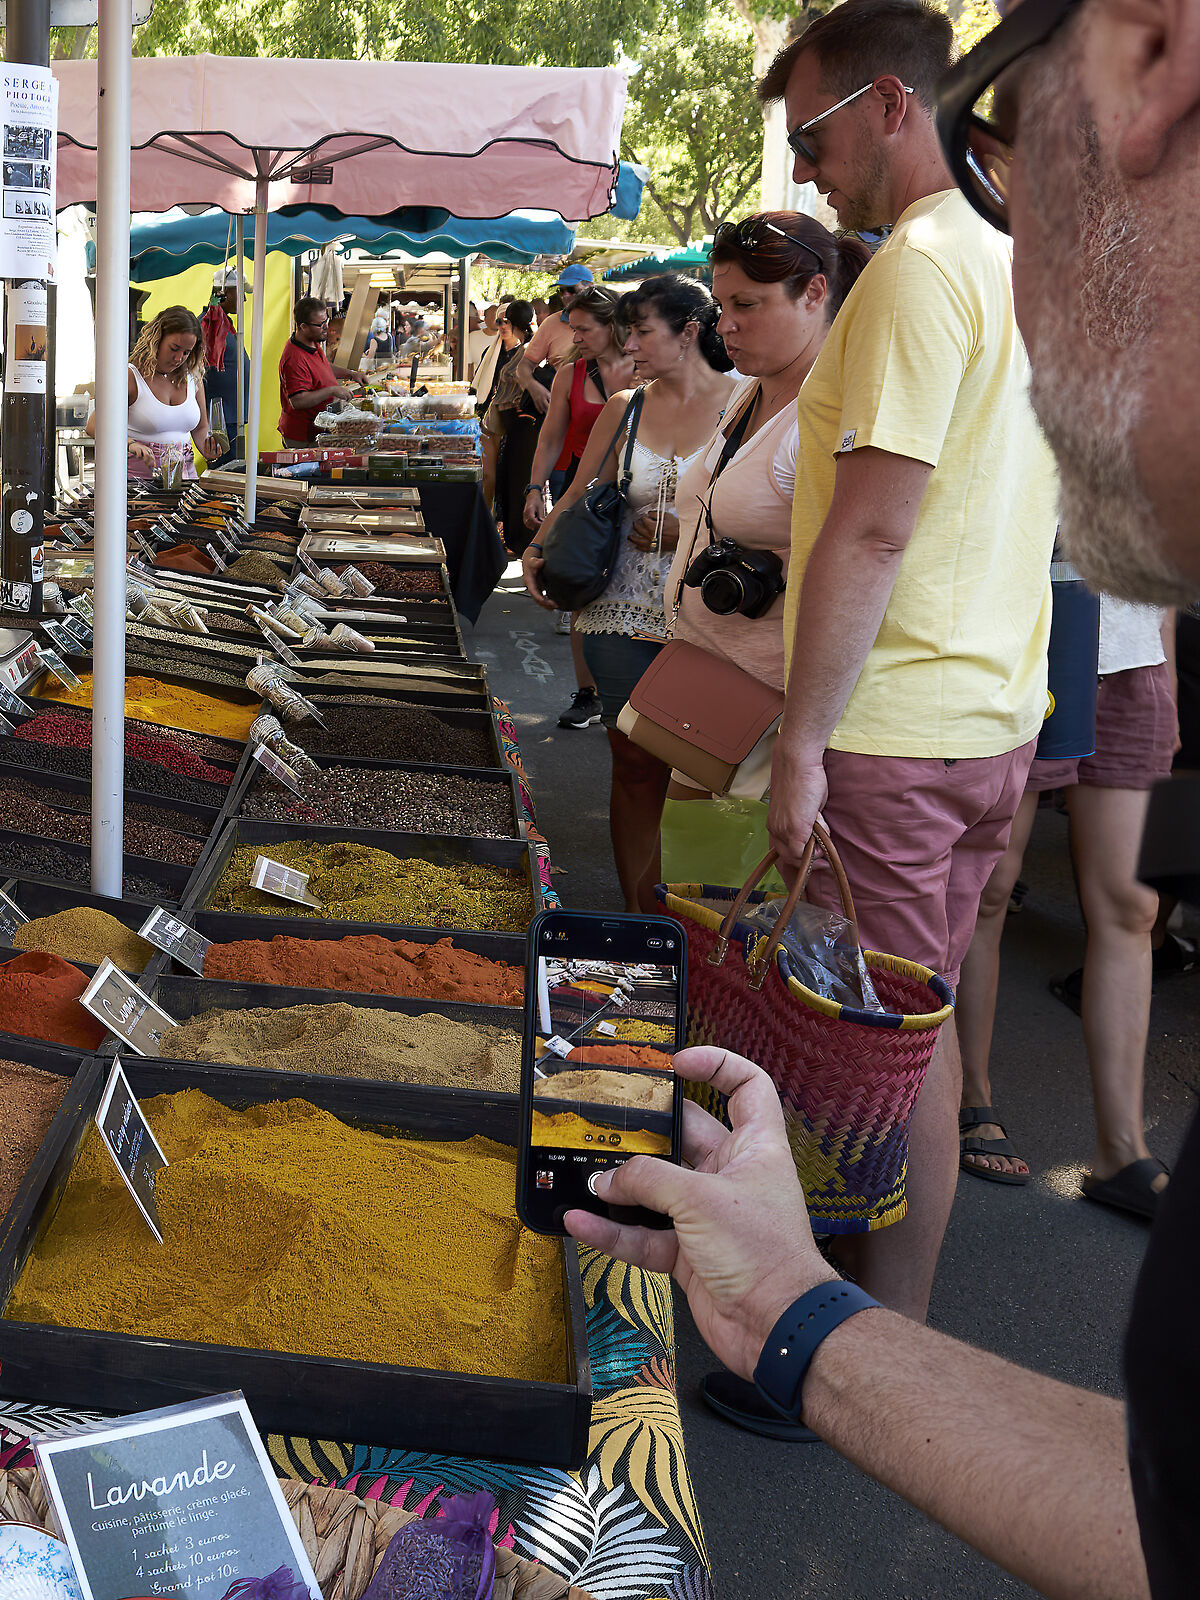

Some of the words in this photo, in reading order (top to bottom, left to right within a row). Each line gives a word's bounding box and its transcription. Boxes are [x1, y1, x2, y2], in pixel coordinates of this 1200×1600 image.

[4, 77, 45, 91] SERGE
[102, 996, 137, 1024] Cumin
[87, 1449, 236, 1510] Lavande
[91, 1514, 132, 1532] Cuisine,
[133, 1504, 186, 1526] pâtisserie,
[186, 1496, 219, 1512] crème
[220, 1486, 252, 1505] glacé,
[131, 1518, 176, 1539] parfume
[177, 1516, 188, 1526] le
[188, 1510, 219, 1527] linge.
[132, 1550, 138, 1561] 1
[144, 1544, 180, 1560] sachet
[185, 1536, 194, 1549] 3
[198, 1532, 231, 1546] euros
[135, 1566, 144, 1578] 4
[147, 1561, 187, 1577] sachets
[189, 1552, 203, 1566] 10
[206, 1548, 241, 1562] euros
[150, 1579, 194, 1596] Grand
[217, 1564, 240, 1577] 10€
